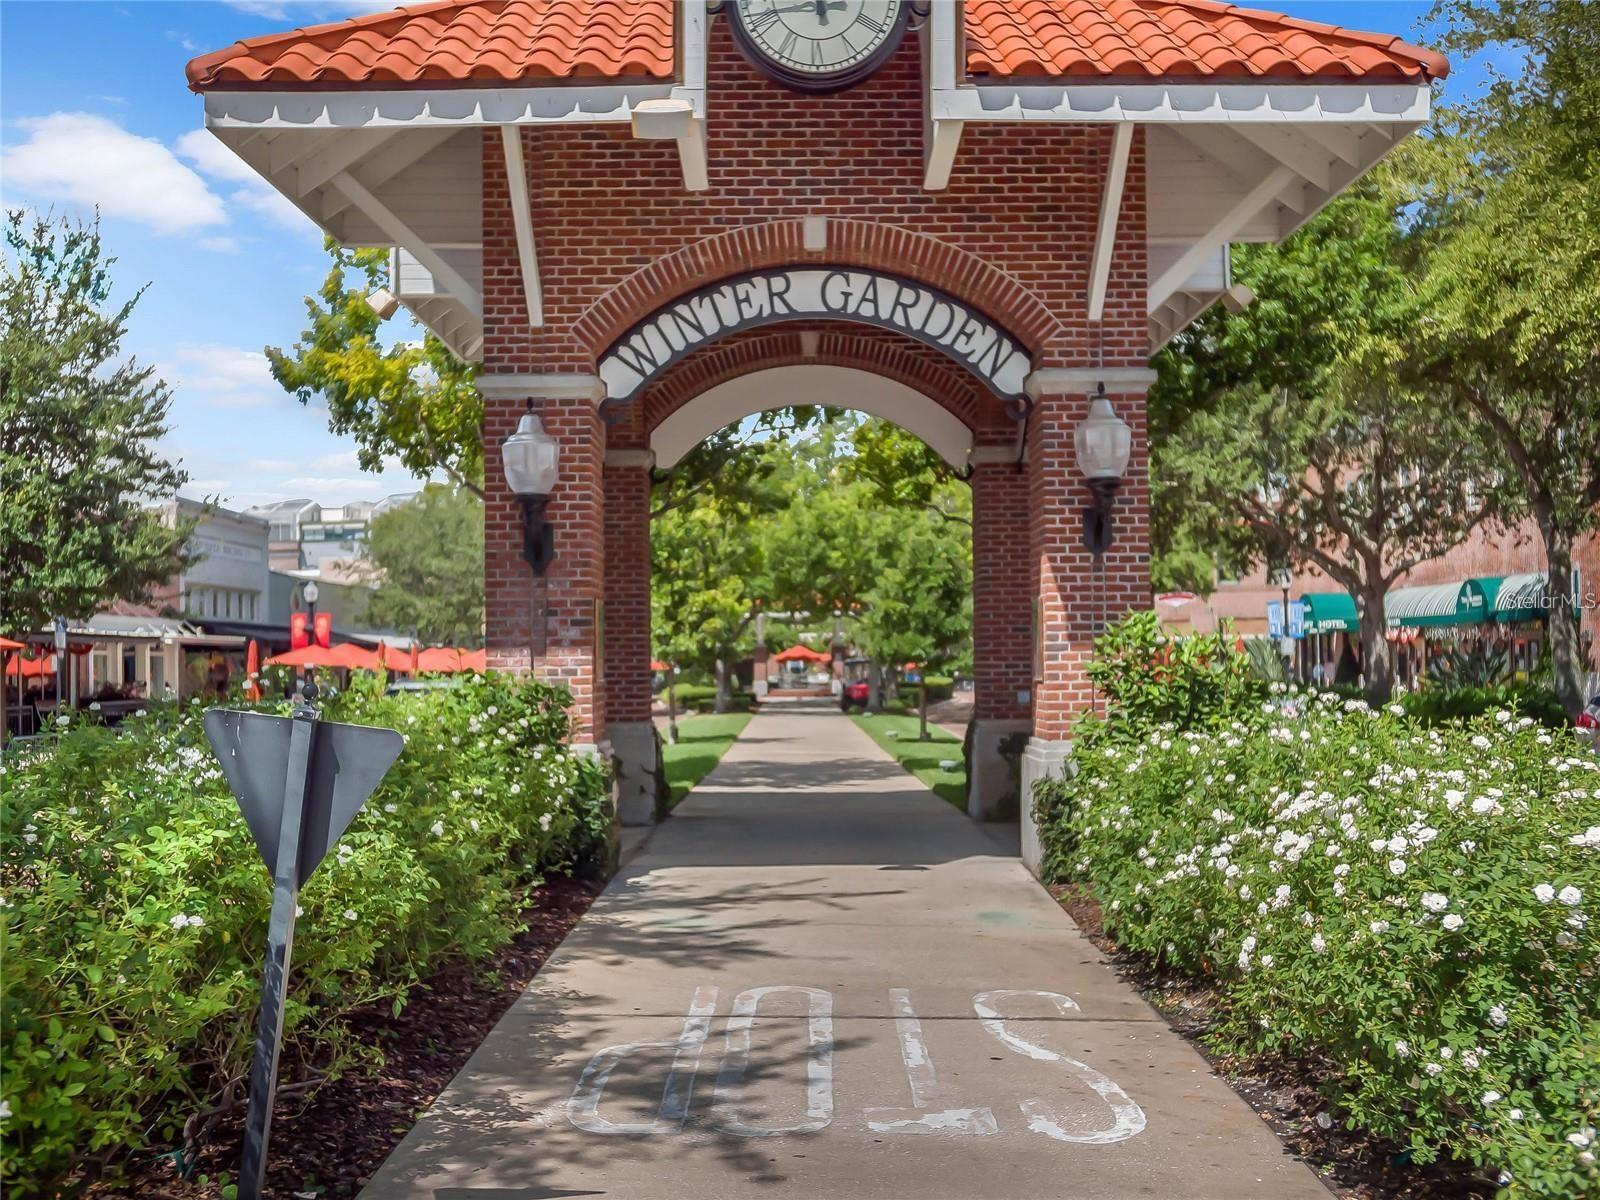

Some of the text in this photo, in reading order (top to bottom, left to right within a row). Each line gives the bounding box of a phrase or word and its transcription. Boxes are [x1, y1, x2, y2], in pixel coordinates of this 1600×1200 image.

[617, 271, 1018, 380] WINTER GARDEN
[1318, 619, 1347, 630] HOTEL
[565, 985, 1148, 1145] STOP
